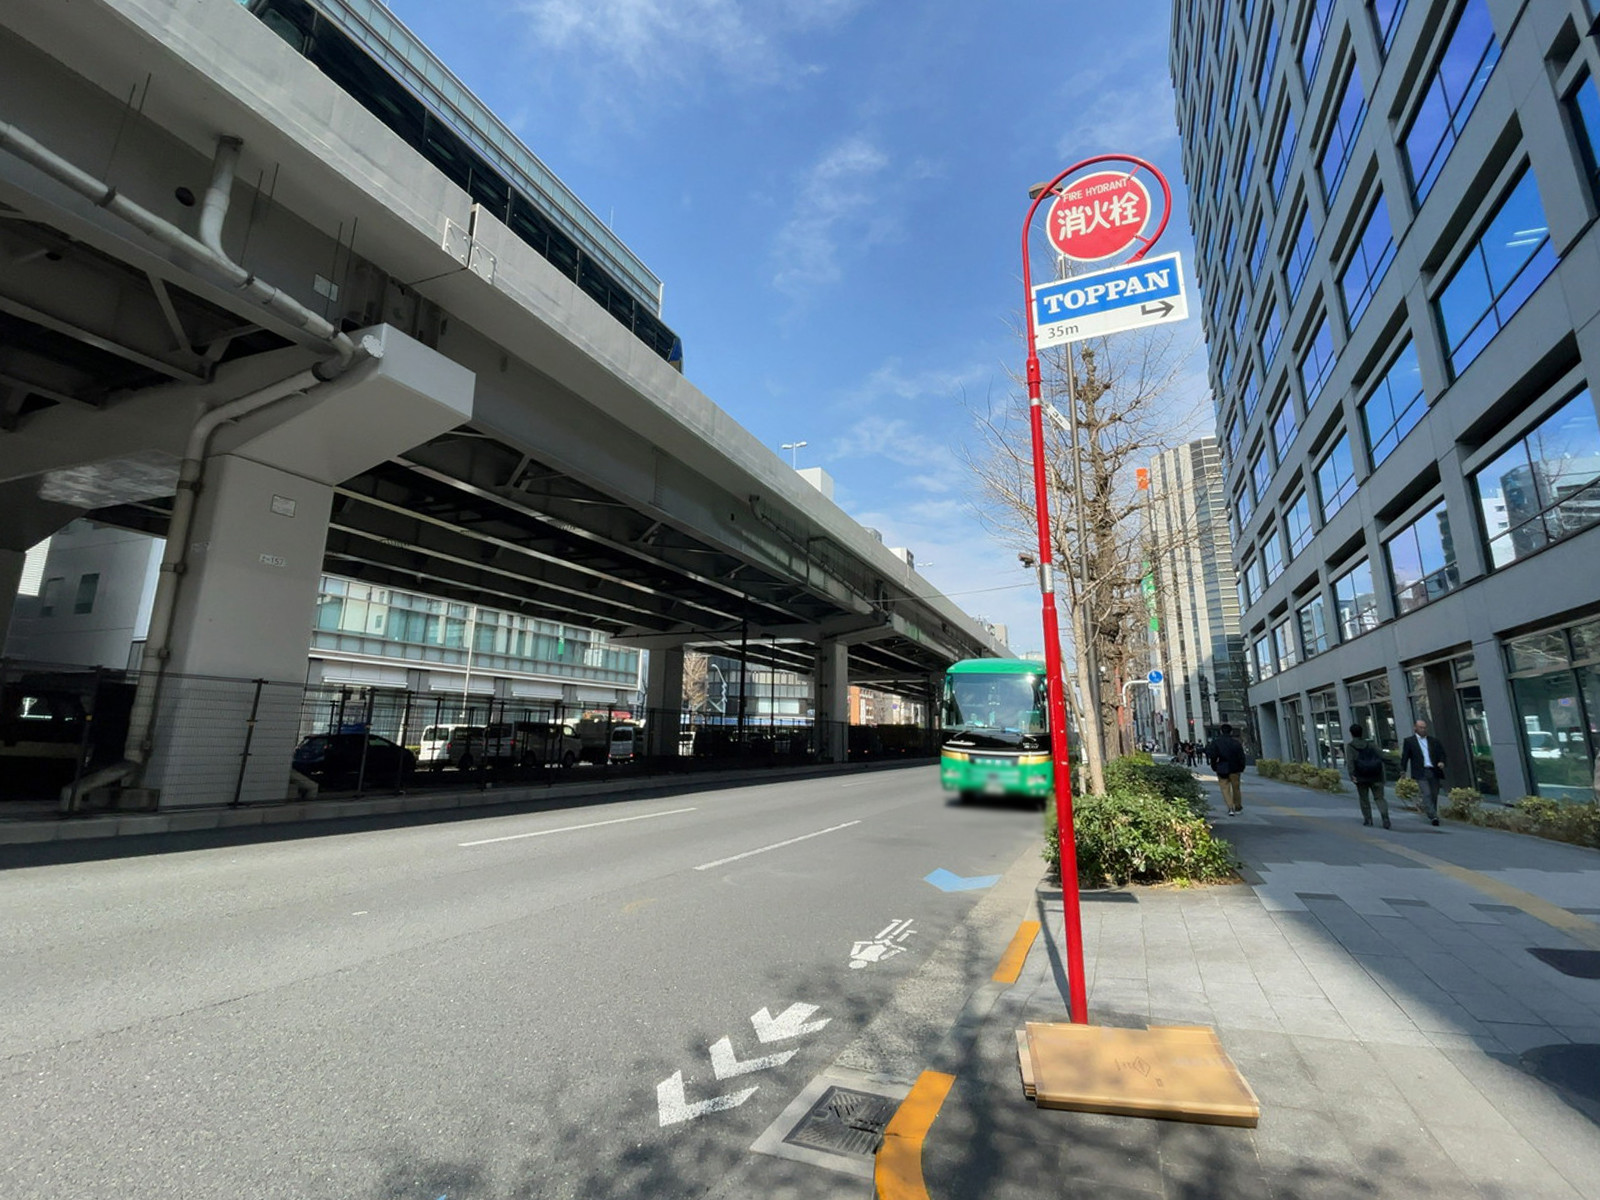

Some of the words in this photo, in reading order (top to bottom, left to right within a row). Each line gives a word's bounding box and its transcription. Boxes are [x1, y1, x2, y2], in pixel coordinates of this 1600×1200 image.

[1062, 189, 1084, 203] FIRE
[1085, 178, 1128, 197] HYDRANT
[1056, 191, 1141, 242] 消火栓
[1043, 268, 1171, 315] TOPPAN
[1047, 324, 1080, 340] 35m
